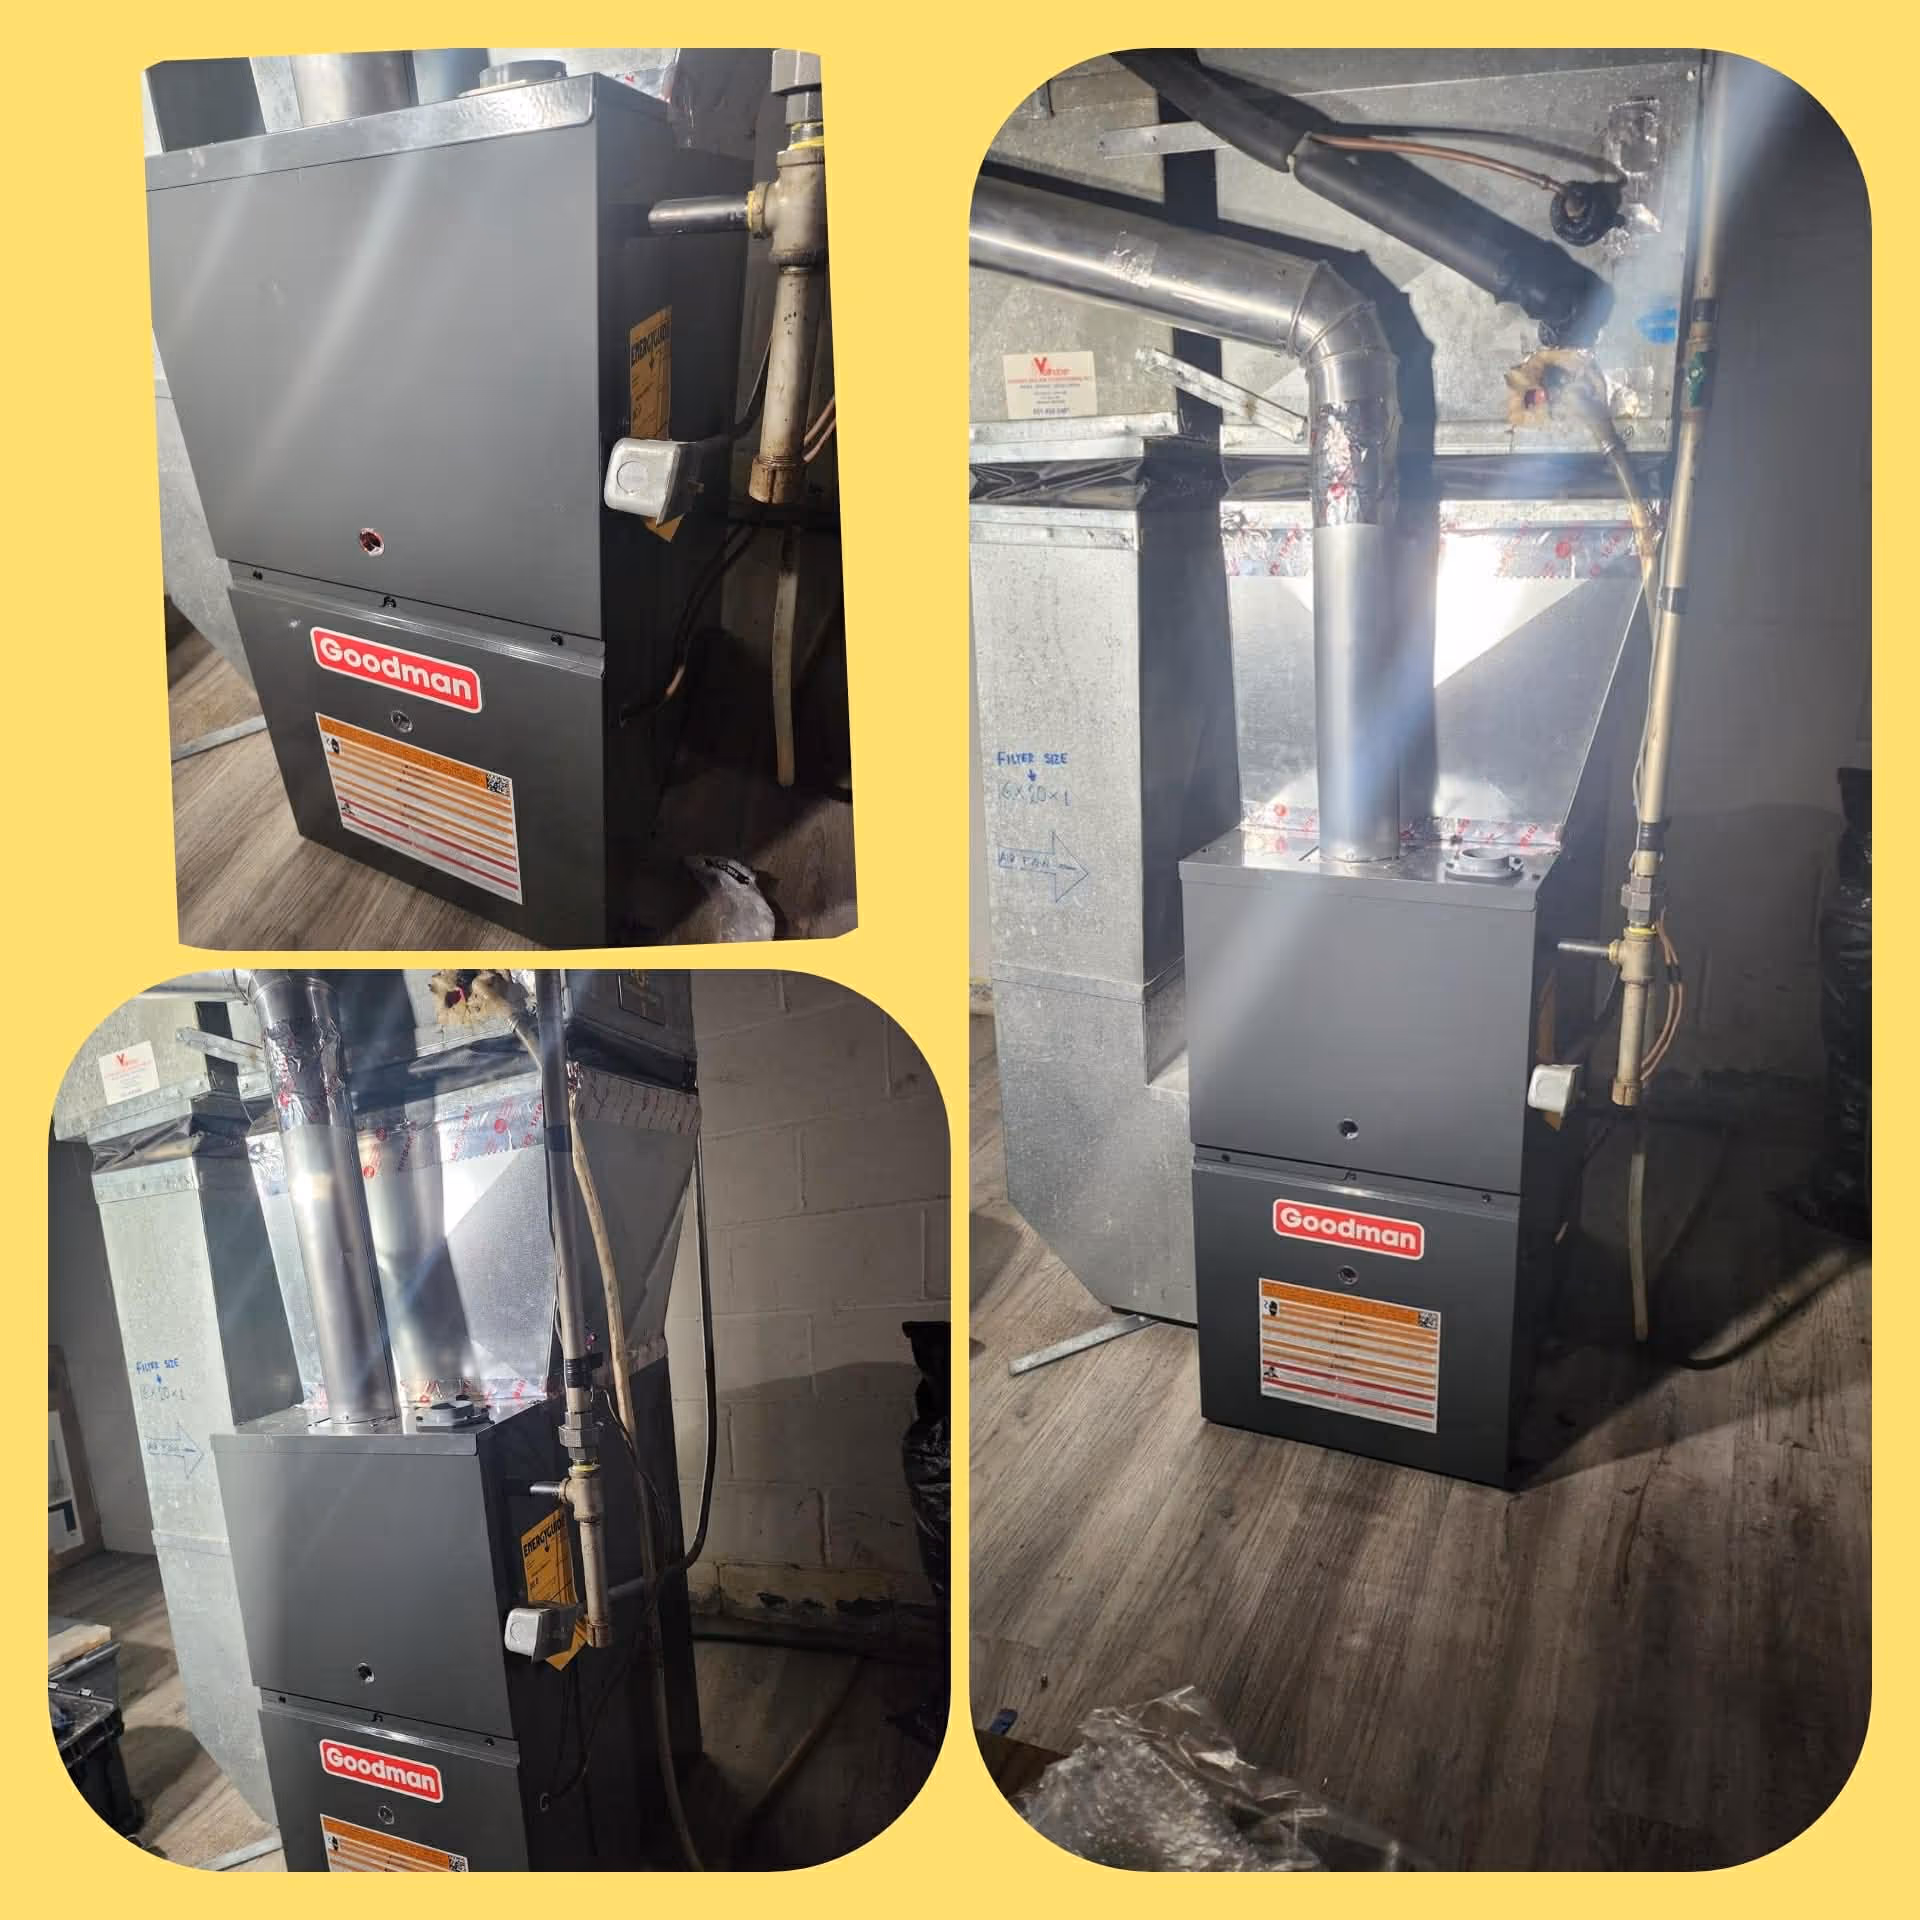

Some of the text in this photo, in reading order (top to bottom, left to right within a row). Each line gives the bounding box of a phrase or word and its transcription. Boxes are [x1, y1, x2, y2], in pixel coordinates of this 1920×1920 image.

[319, 637, 472, 701] Goodman
[997, 752, 1069, 766] FILTER SIZE
[1280, 1207, 1416, 1250] Goodman
[326, 1747, 436, 1793] Goodman
